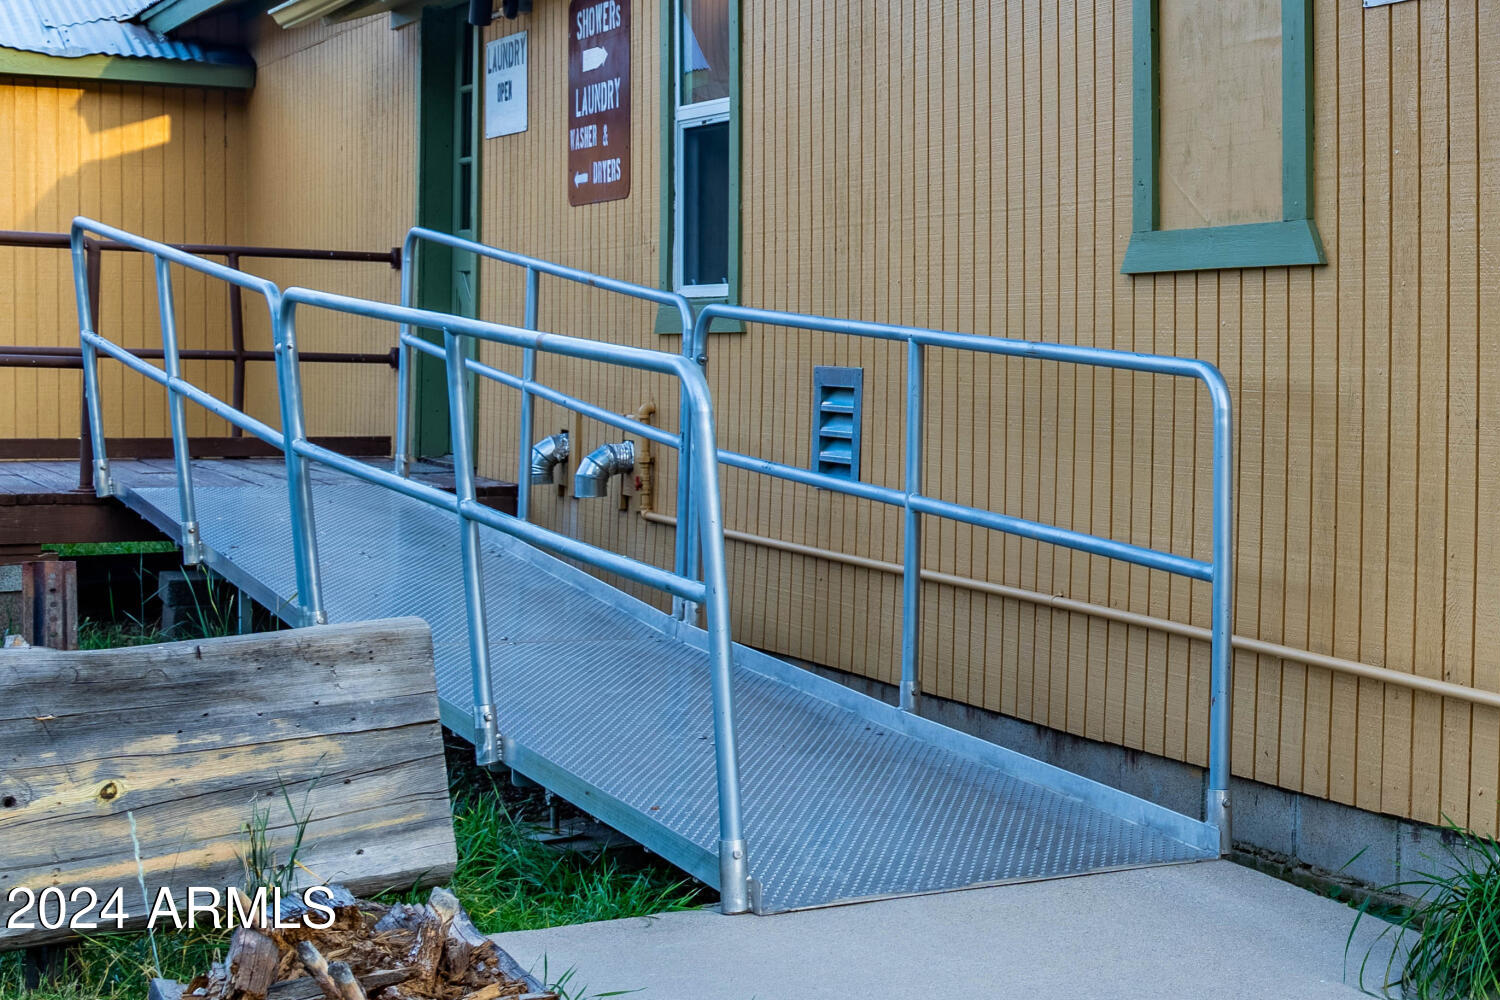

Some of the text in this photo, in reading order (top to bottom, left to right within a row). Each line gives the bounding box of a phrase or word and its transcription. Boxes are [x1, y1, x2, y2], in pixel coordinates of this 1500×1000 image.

[487, 36, 526, 75] LAUNDRY
[497, 80, 513, 103] OPEN
[575, 77, 621, 119] LAUNDRY
[570, 123, 609, 152] WASHER &
[592, 157, 621, 185] DRYERS
